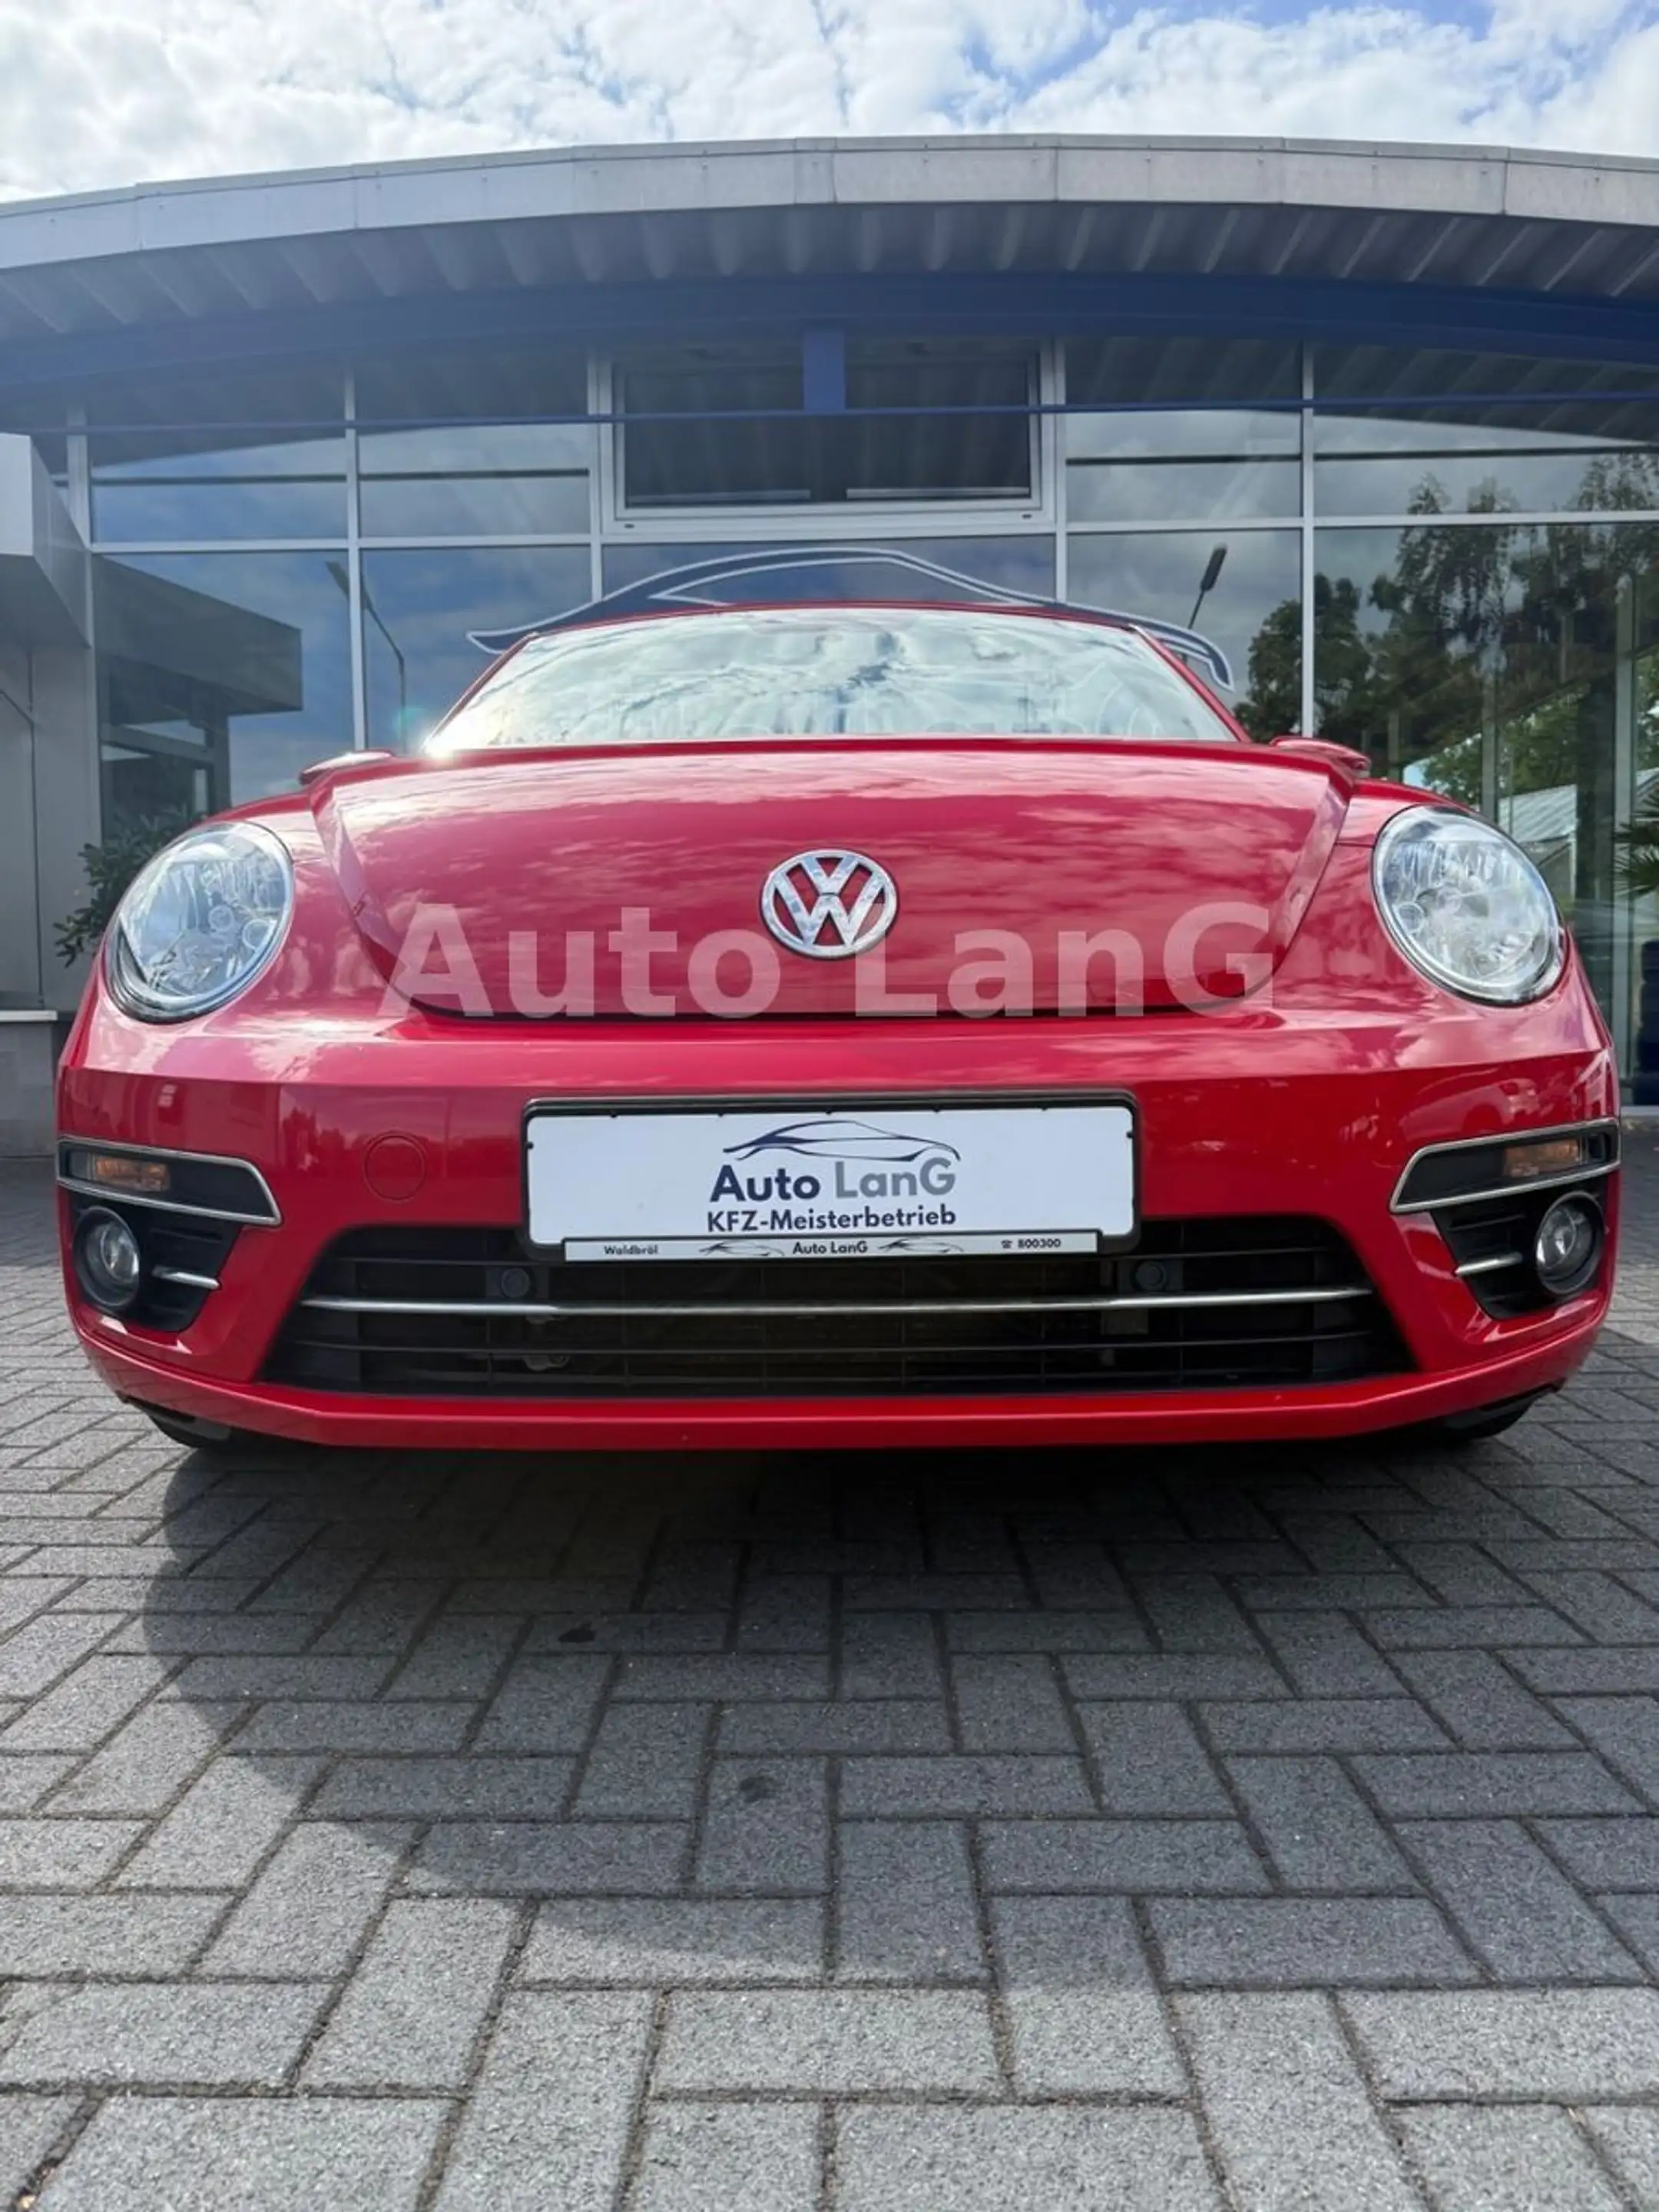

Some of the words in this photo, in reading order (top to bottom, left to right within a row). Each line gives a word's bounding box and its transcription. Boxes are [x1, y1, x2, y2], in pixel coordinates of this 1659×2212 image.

[710, 1164, 820, 1202] Auto
[835, 1157, 956, 1199] LanG
[707, 1204, 956, 1232] KFZ-Meisterbetrieb
[793, 1242, 826, 1255] Auto
[831, 1240, 868, 1253] LanG
